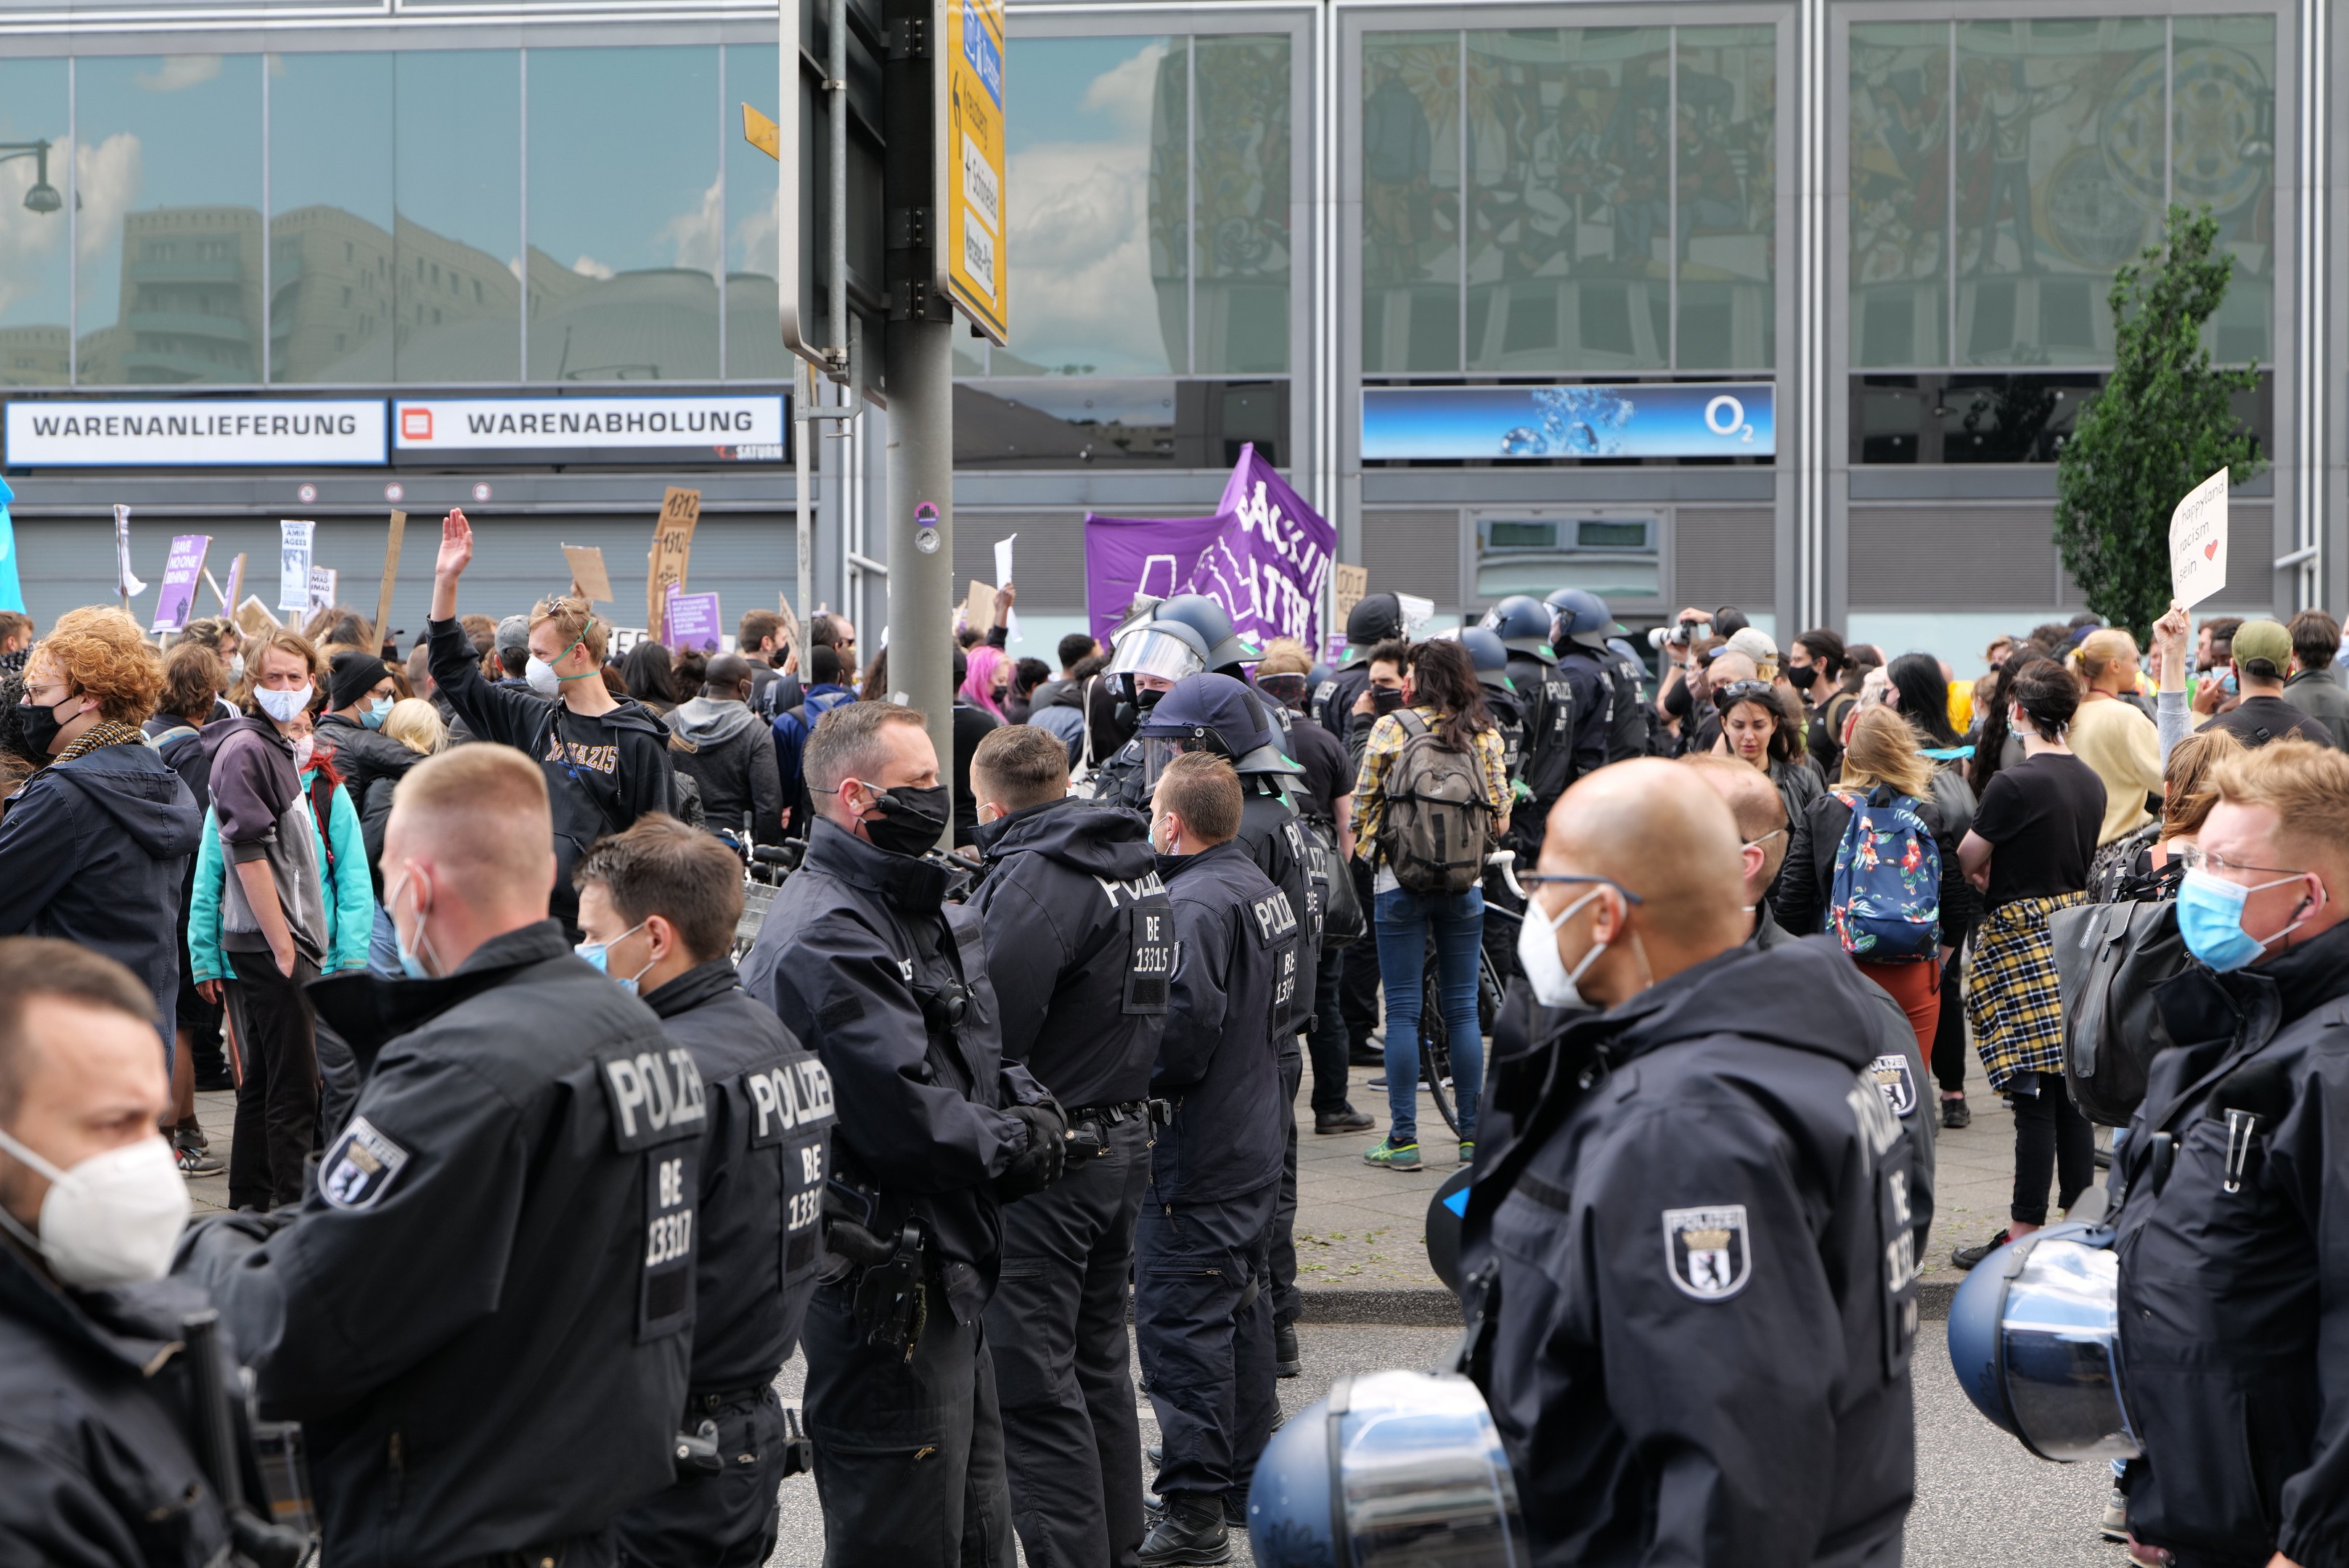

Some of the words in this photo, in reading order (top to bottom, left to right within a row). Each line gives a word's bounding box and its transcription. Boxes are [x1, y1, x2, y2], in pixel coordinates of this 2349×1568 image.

[33, 415, 356, 436] WARENANLIEFERUNG
[467, 411, 753, 434] WARENABHOLUNG
[735, 444, 783, 460] SATURN
[667, 492, 698, 518] 1312
[2181, 475, 2224, 524] happyland
[172, 539, 192, 555] LEAVE
[662, 531, 685, 554] 1312
[2180, 521, 2210, 555] racism
[168, 556, 181, 570] NO
[181, 555, 197, 568] ONE
[2179, 558, 2197, 583] sein
[165, 571, 189, 585] BEHIND
[566, 742, 619, 775] NAZIS
[1145, 916, 1160, 942] BE
[1133, 947, 1169, 973] 13315
[1284, 950, 1295, 976] BE
[801, 1143, 822, 1185] BE
[659, 1157, 682, 1208] BE
[645, 1209, 693, 1267] 13317
